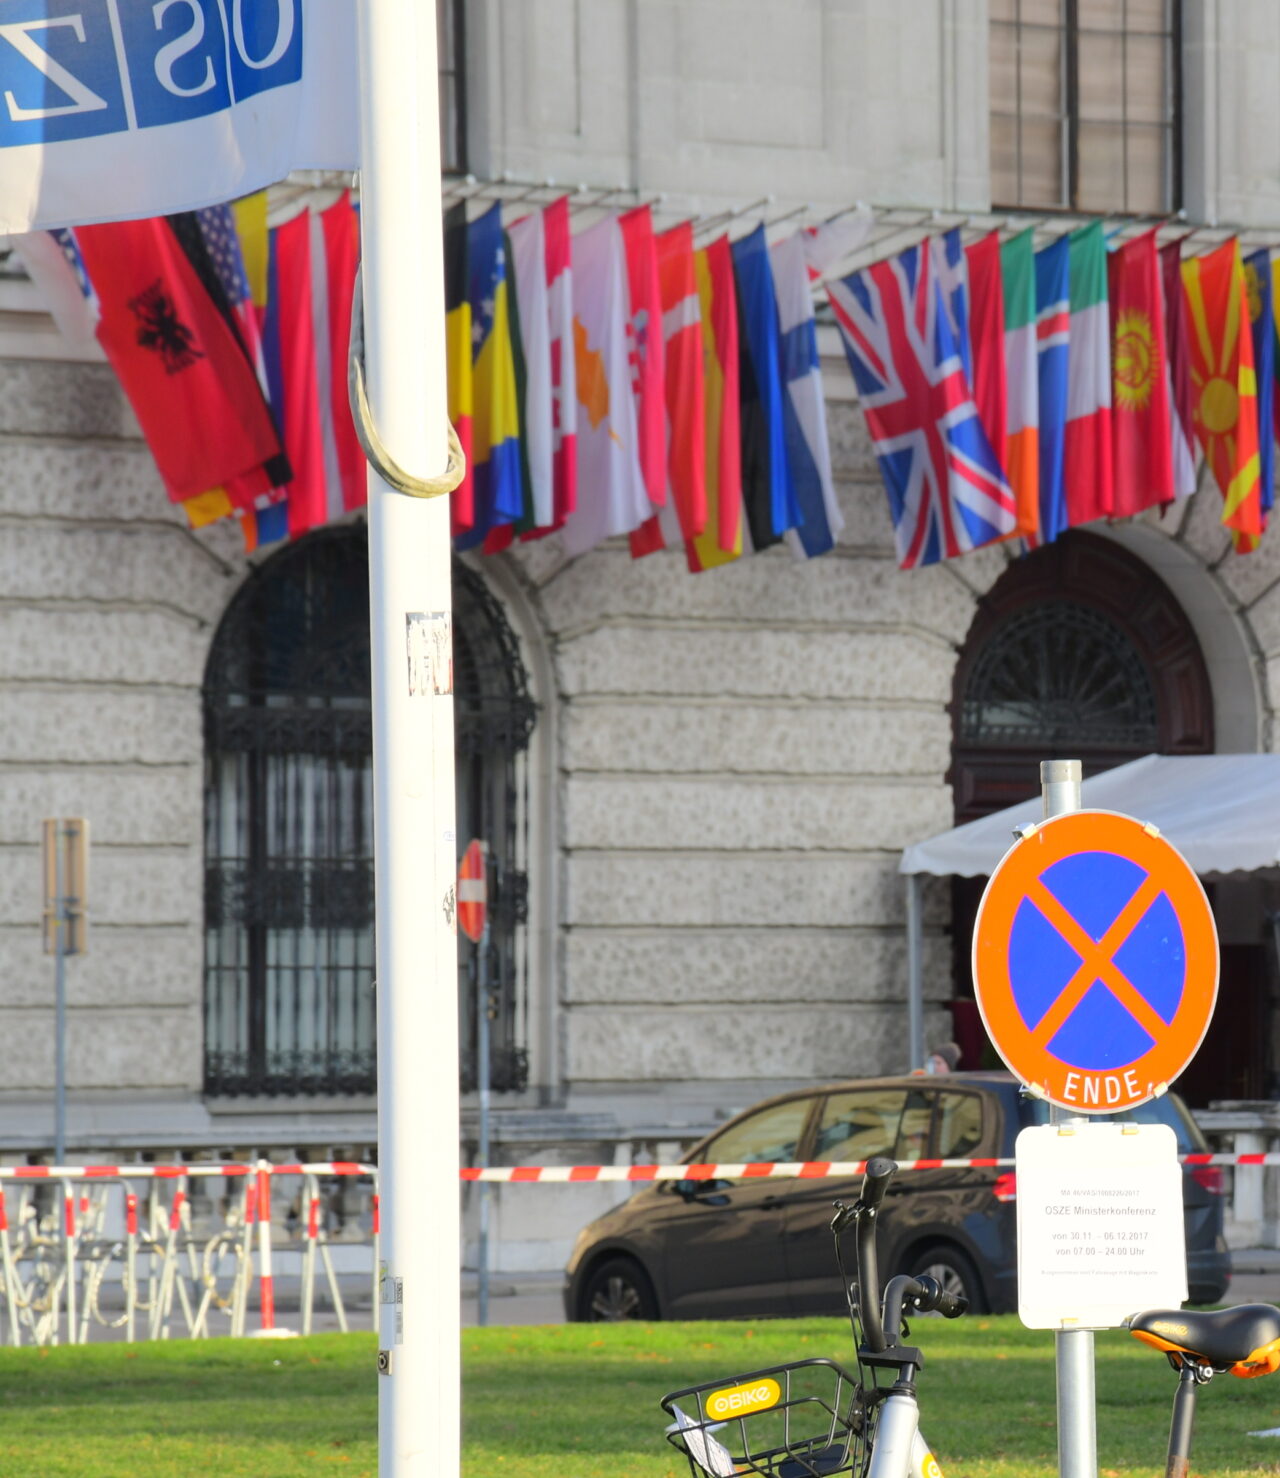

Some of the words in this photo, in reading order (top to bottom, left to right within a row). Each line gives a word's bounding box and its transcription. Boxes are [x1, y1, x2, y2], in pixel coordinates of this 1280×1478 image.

[1063, 1069, 1141, 1104] ENDE
[1045, 1205, 1071, 1216] OSZE
[1074, 1205, 1157, 1216] Ministerkonferenz
[1052, 1233, 1067, 1241] von
[1055, 1248, 1070, 1256] von
[1129, 1246, 1145, 1256] Uhr
